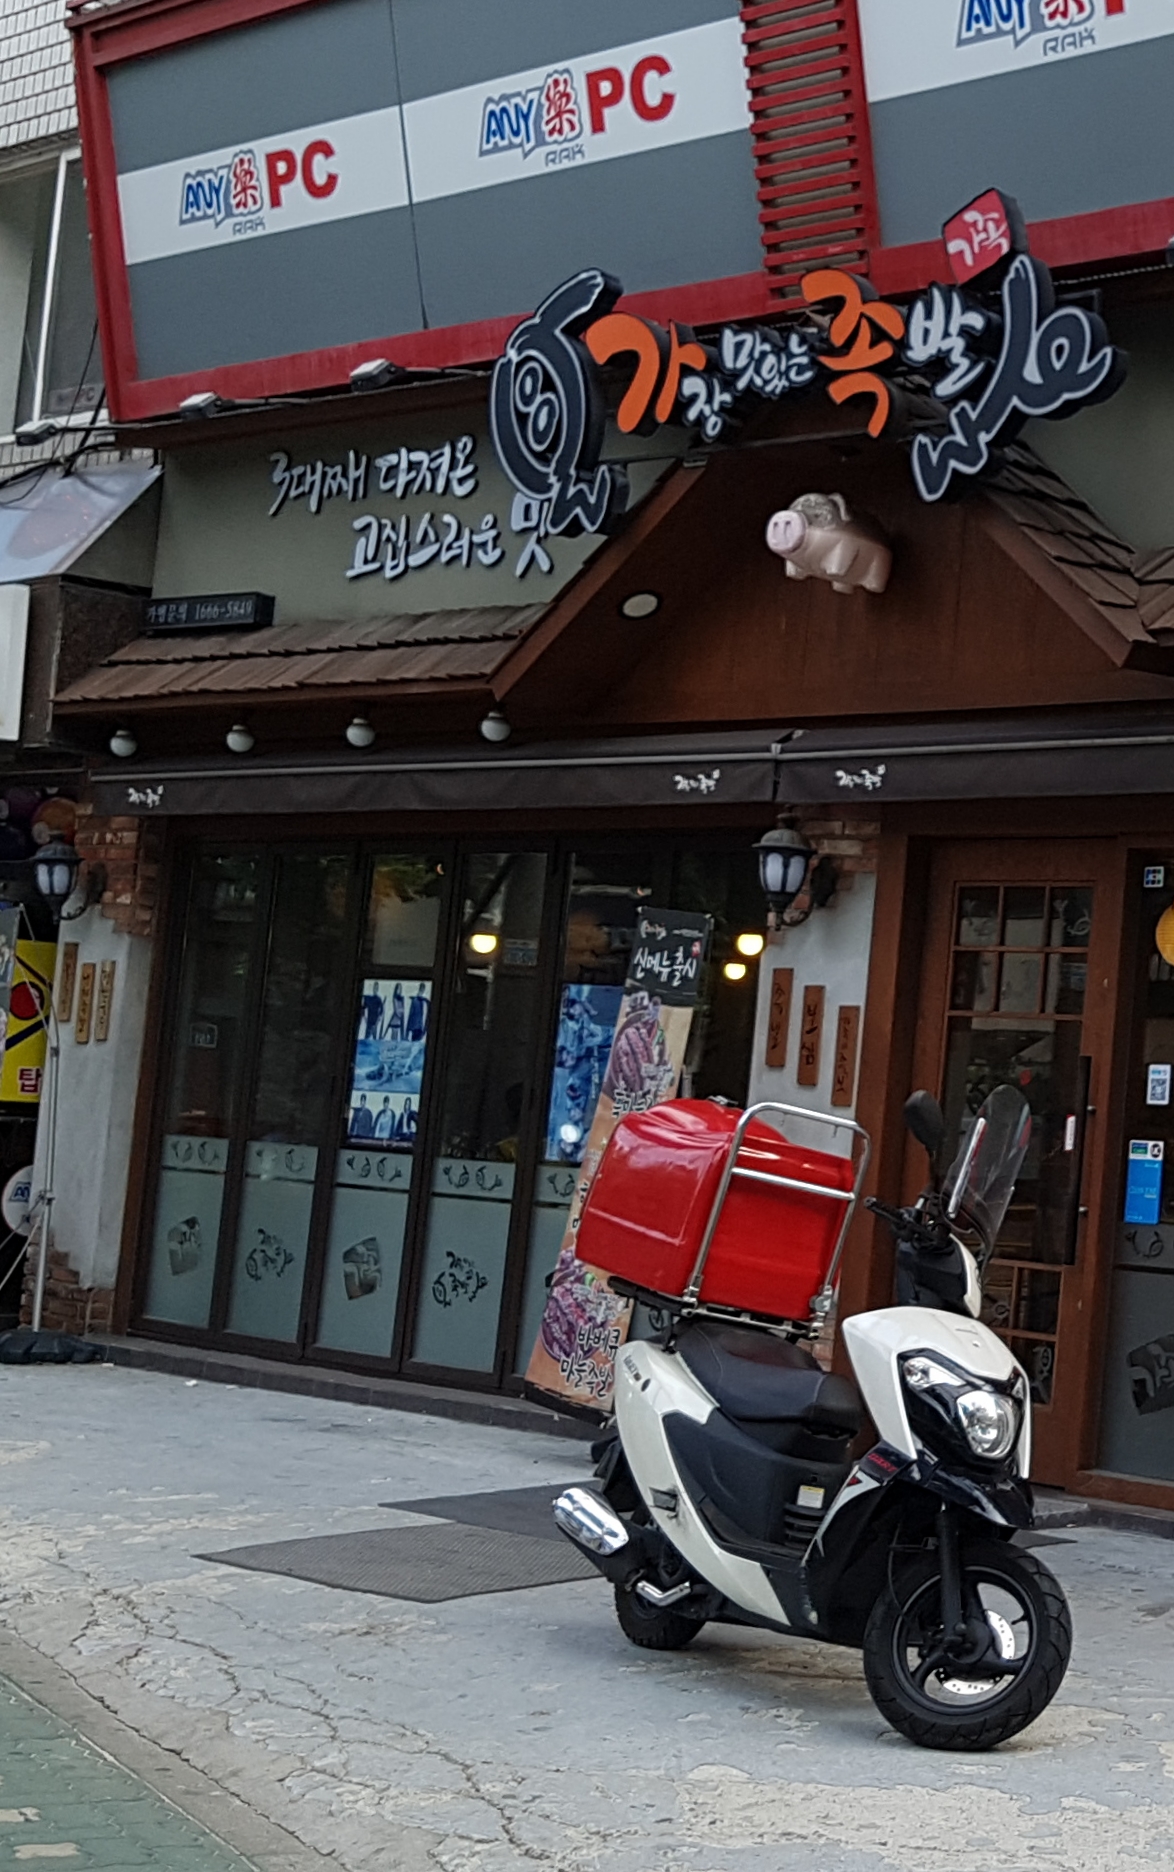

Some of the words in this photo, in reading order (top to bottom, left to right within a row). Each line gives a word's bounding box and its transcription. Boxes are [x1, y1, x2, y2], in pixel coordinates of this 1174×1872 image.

[1042, 28, 1096, 56] RAK
[485, 98, 534, 145] ANY
[585, 55, 676, 135] PC
[545, 144, 585, 167] RAK
[184, 175, 224, 215] ANY
[265, 139, 339, 209] PC
[232, 215, 266, 236] RAK
[719, 327, 813, 397] 맛있는
[801, 269, 986, 438] 족발
[346, 512, 504, 580] 고집스러운
[577, 1326, 621, 1362] 바베큐
[560, 1356, 614, 1398] 마늘족발
